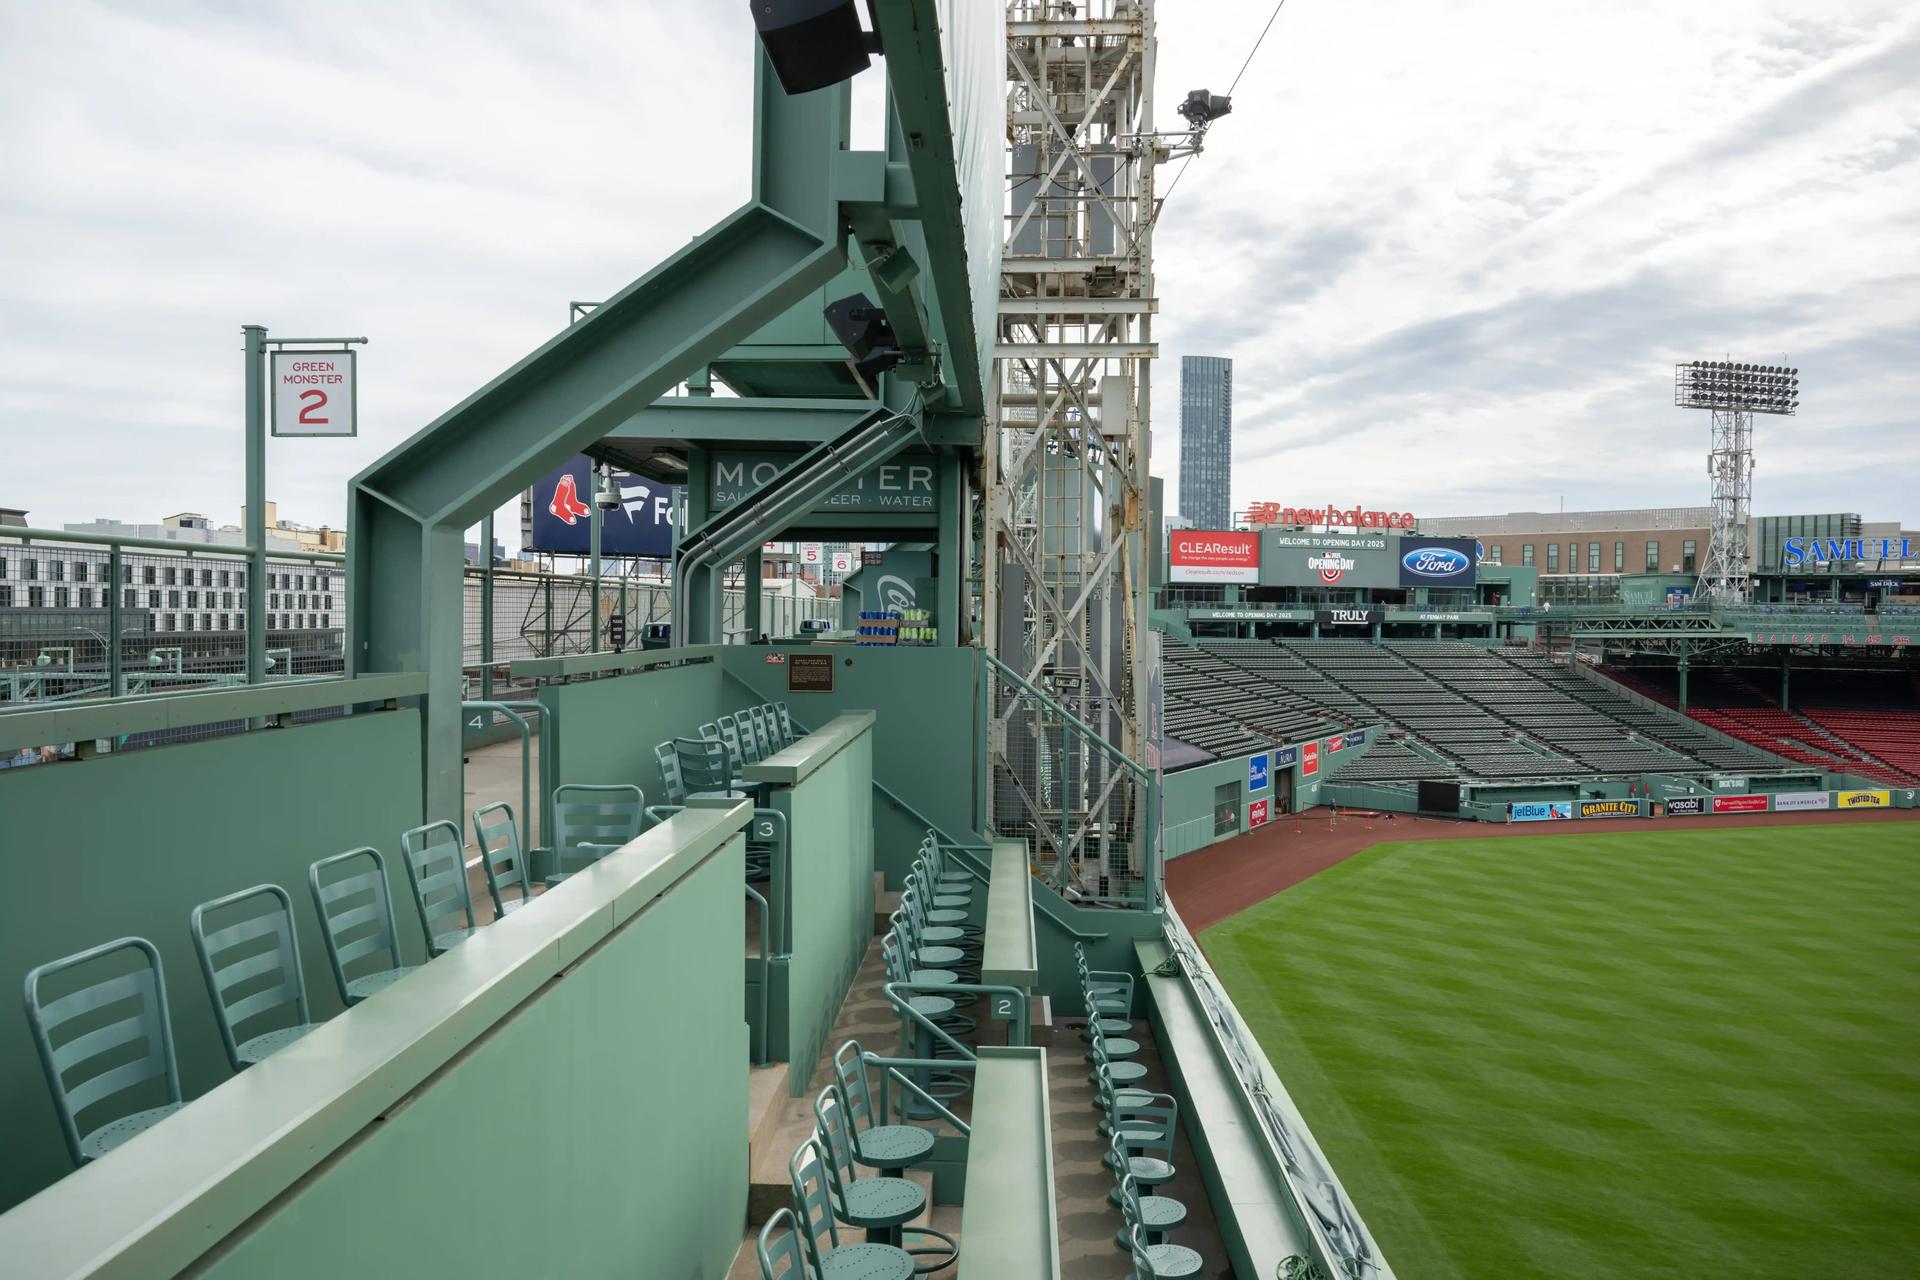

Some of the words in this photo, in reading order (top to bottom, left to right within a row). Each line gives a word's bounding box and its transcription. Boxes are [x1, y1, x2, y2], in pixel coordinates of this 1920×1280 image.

[292, 362, 335, 372] GREEN
[283, 374, 343, 384] MONSTER
[298, 389, 329, 424] 2
[716, 461, 934, 491] MOER
[824, 494, 861, 505] EER
[879, 495, 933, 507] WATER
[1283, 507, 1327, 526] new
[1327, 504, 1415, 529] balance
[1179, 541, 1251, 554] CLEAResult
[1279, 537, 1310, 546] WELCOME
[1312, 538, 1321, 546] TO
[1322, 539, 1350, 547] OPENING
[1367, 540, 1385, 548] 2025
[807, 550, 817, 561] 5
[1783, 536, 1920, 566] SAMUEL
[837, 560, 847, 570] 6
[1308, 557, 1340, 570] OPENING
[1340, 558, 1355, 571] DAY
[1415, 551, 1457, 572] Ford
[1330, 610, 1369, 621] TRULY
[468, 714, 484, 729] 4
[1669, 799, 1699, 809] wasabi
[1848, 794, 1871, 806] TWISTED
[1870, 796, 1881, 805] TEA
[1513, 804, 1545, 819] jetBlue
[1582, 802, 1618, 816] GRANITE
[1619, 801, 1638, 814] CITY
[758, 821, 774, 838] 3
[998, 999, 1012, 1015] 2
